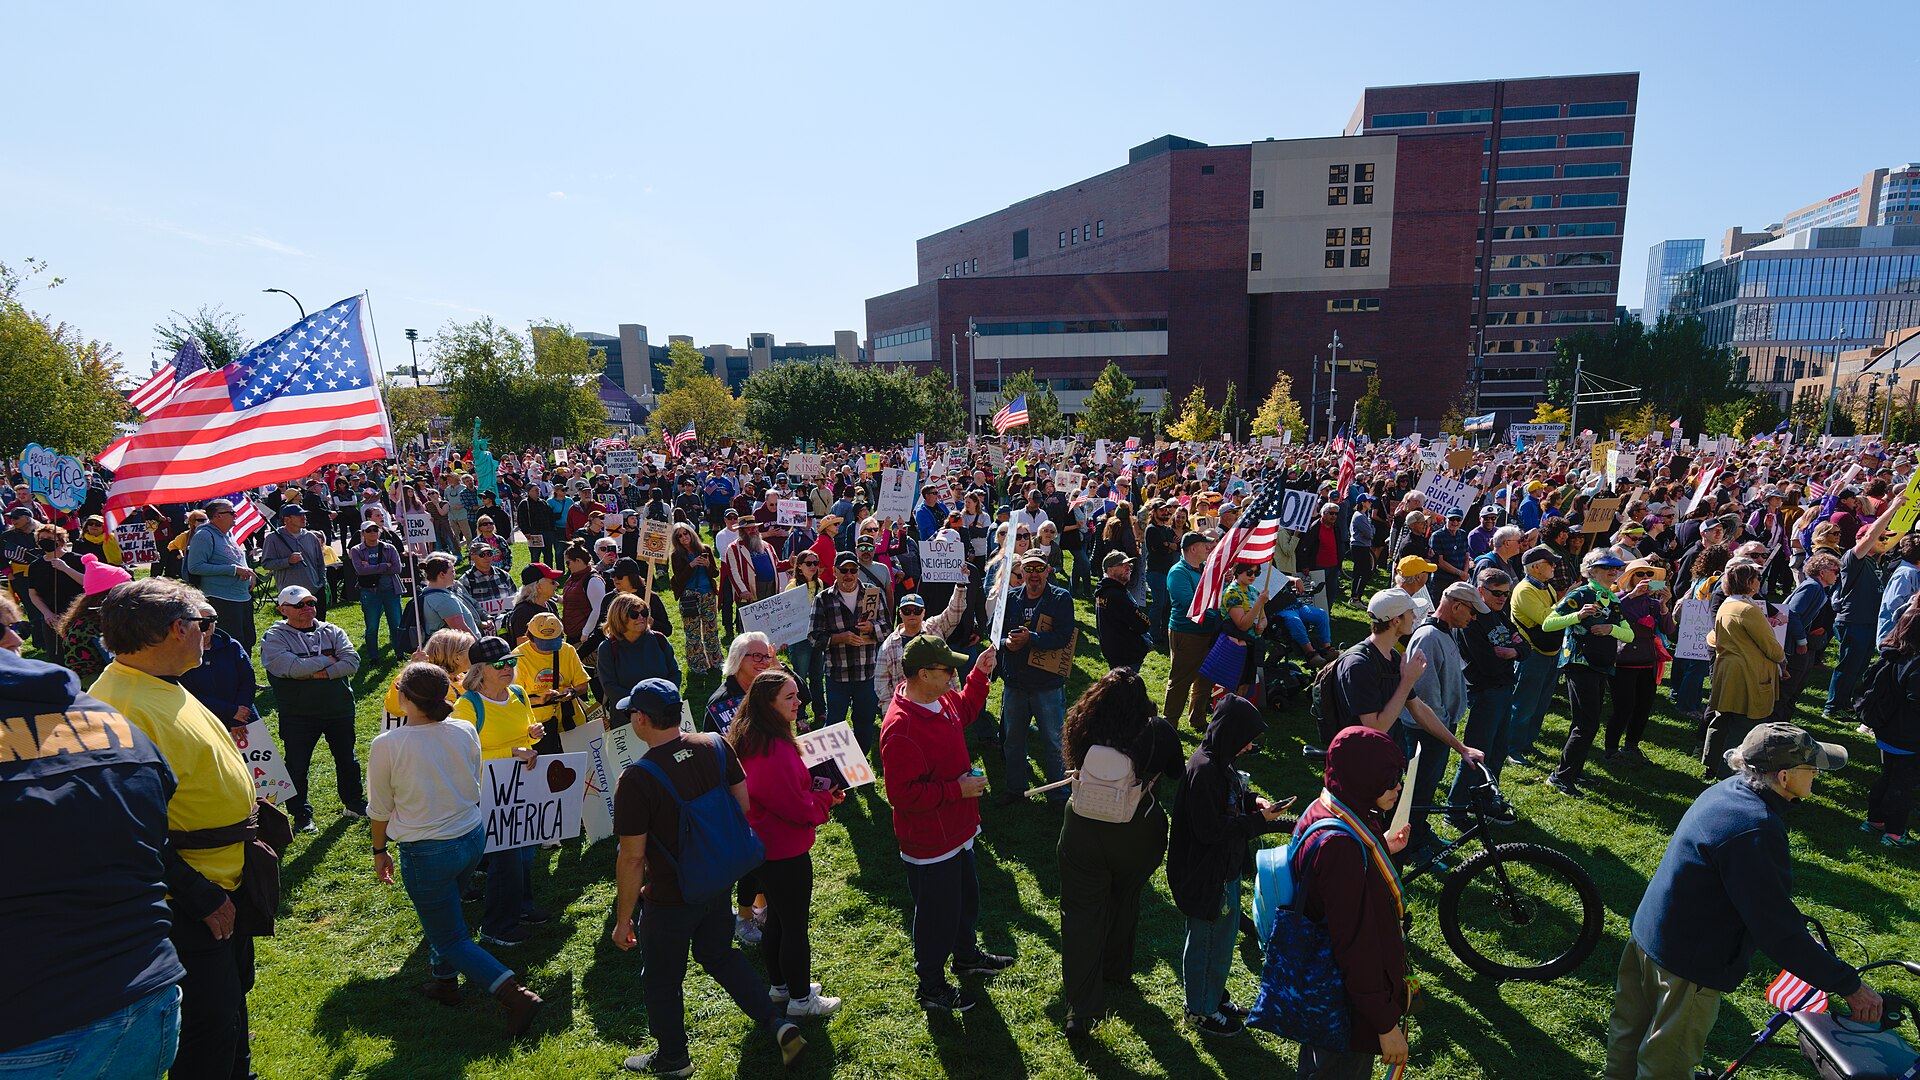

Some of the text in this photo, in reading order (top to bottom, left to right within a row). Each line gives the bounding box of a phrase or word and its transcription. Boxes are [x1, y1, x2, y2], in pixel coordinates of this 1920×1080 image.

[1425, 486, 1460, 508] RURAL
[118, 532, 149, 541] PEOPLE
[642, 551, 664, 559] FASCISM
[929, 542, 954, 552] LOVE
[921, 558, 963, 569] NEIGHBOR
[923, 572, 967, 581] NO EXCEPTIONS
[743, 597, 782, 616] IMAGINE
[1687, 601, 1698, 609] Say
[0, 710, 134, 763] NAVY
[612, 728, 628, 755] FROM
[589, 737, 609, 793] Democracy
[673, 748, 693, 763] DFL
[488, 760, 528, 806] WE
[485, 798, 563, 847] AMERICA
[1431, 842, 1459, 864] SURLY
